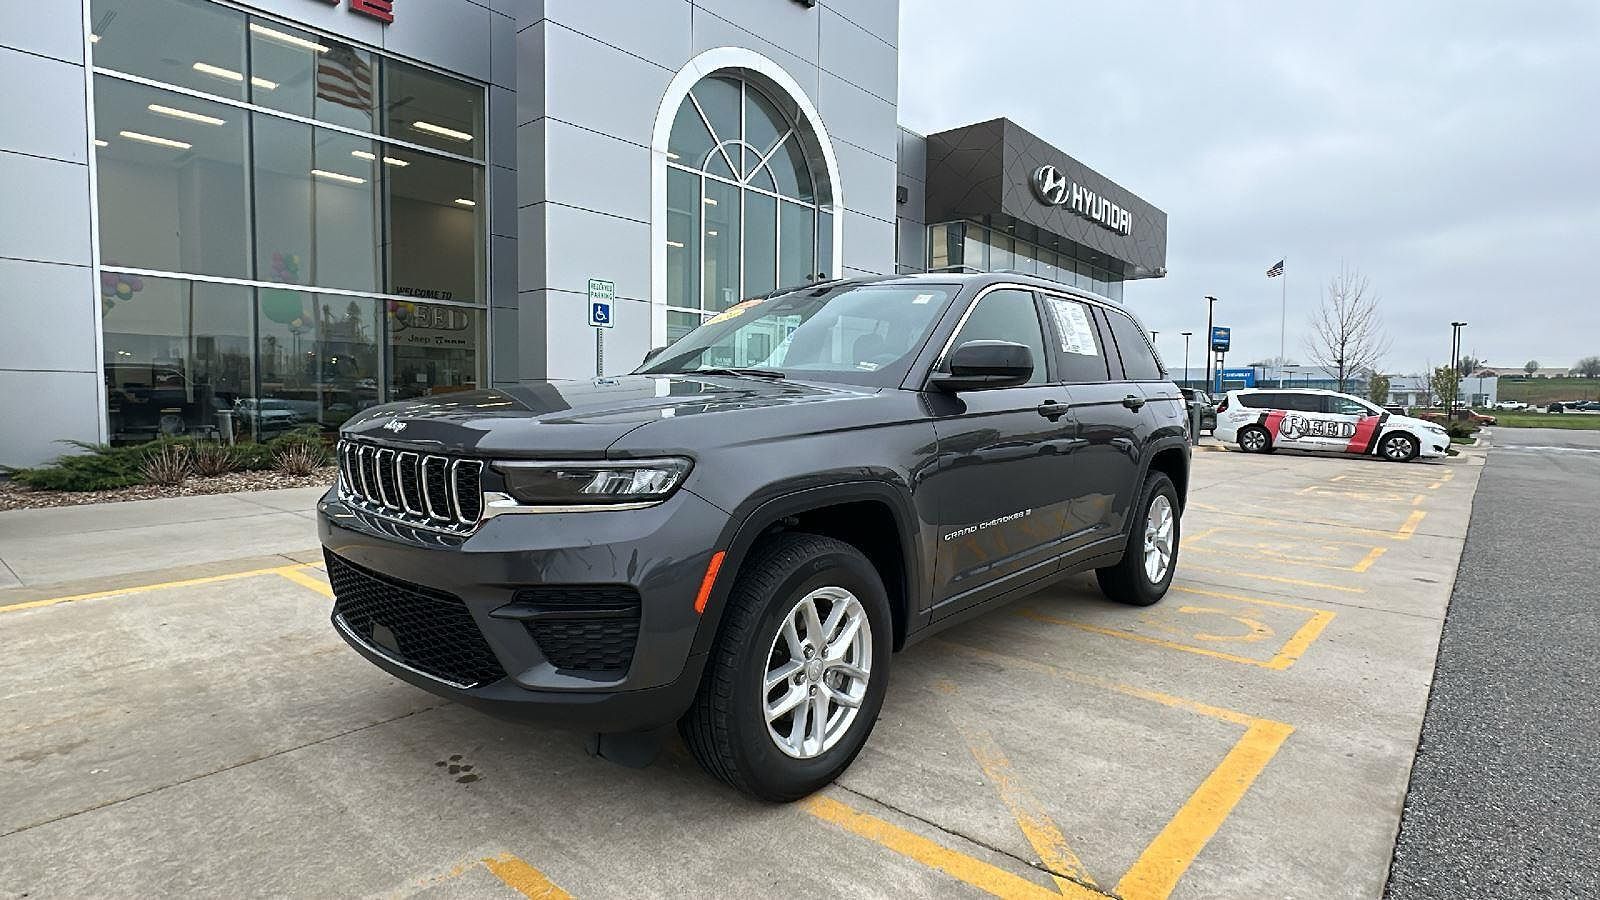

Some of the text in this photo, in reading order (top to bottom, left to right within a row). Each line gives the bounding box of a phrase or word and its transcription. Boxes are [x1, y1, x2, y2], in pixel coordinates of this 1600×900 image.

[1072, 182, 1132, 235] HYUNDAI
[396, 286, 452, 300] WELCOME TO
[1280, 415, 1356, 439] REED
[944, 511, 1024, 541] GRAND CHEROKEE
